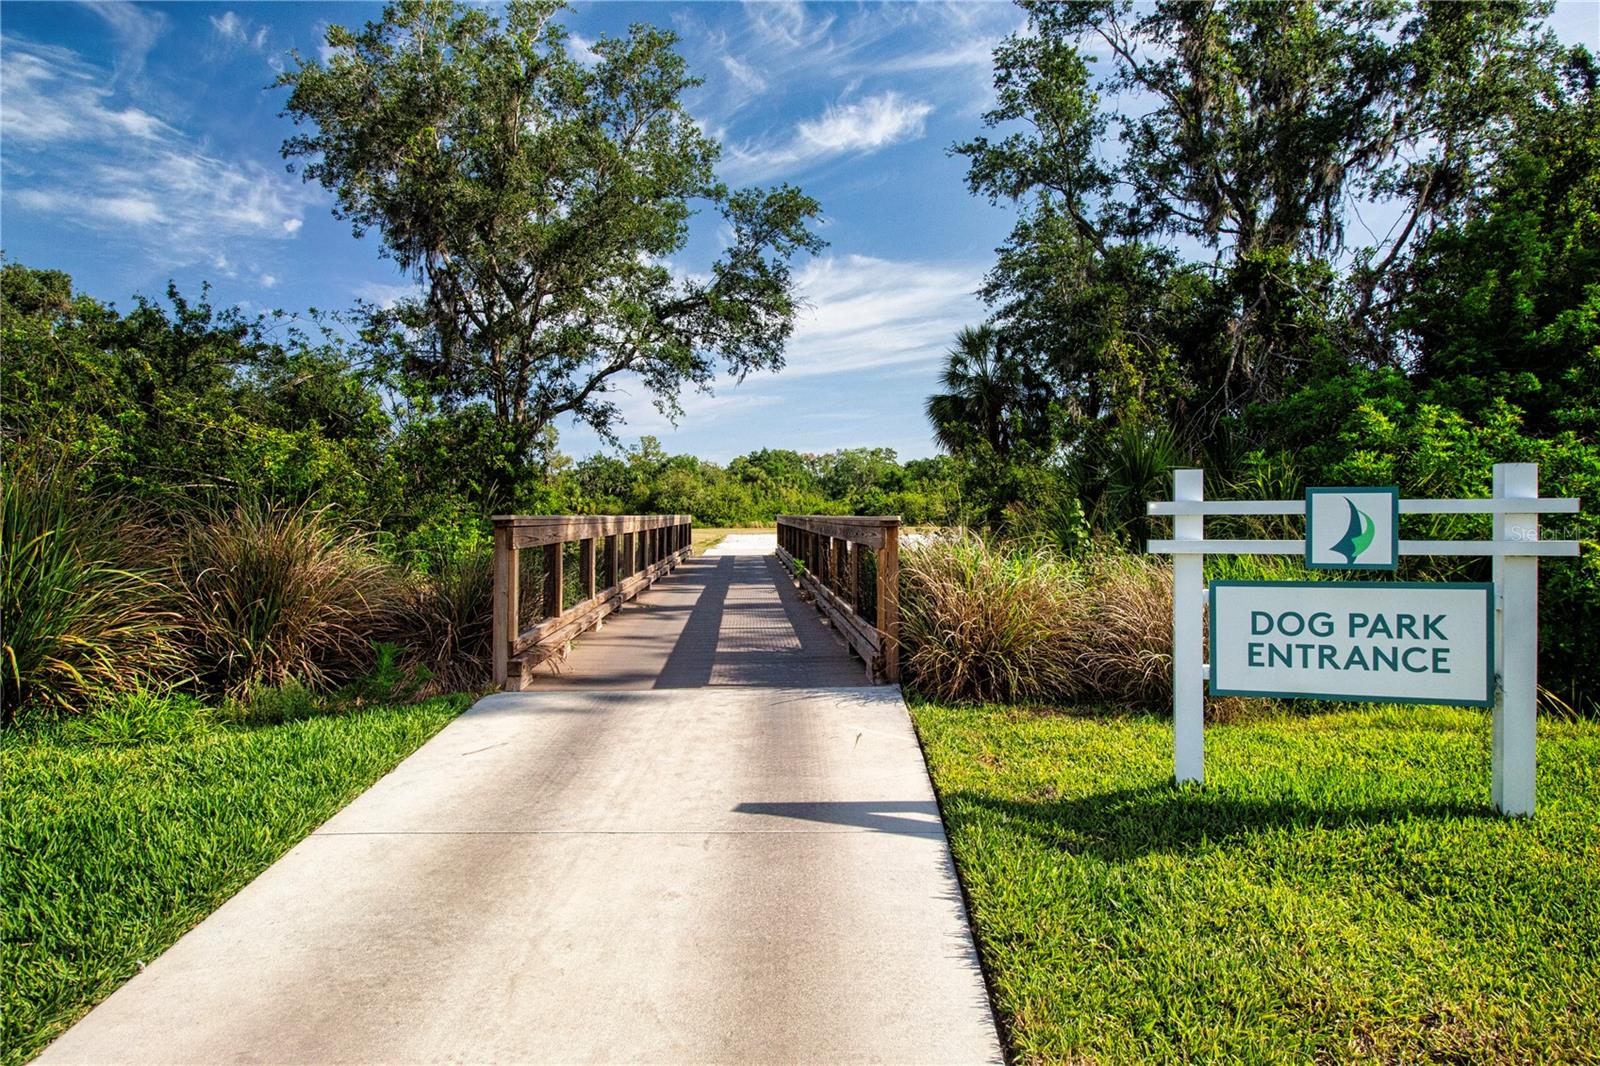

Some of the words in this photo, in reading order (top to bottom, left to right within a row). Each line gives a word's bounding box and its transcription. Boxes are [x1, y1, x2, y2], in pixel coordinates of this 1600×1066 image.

[1250, 610, 1335, 638] DOG
[1348, 612, 1449, 641] PARK
[1247, 642, 1452, 674] ENTRANCE
